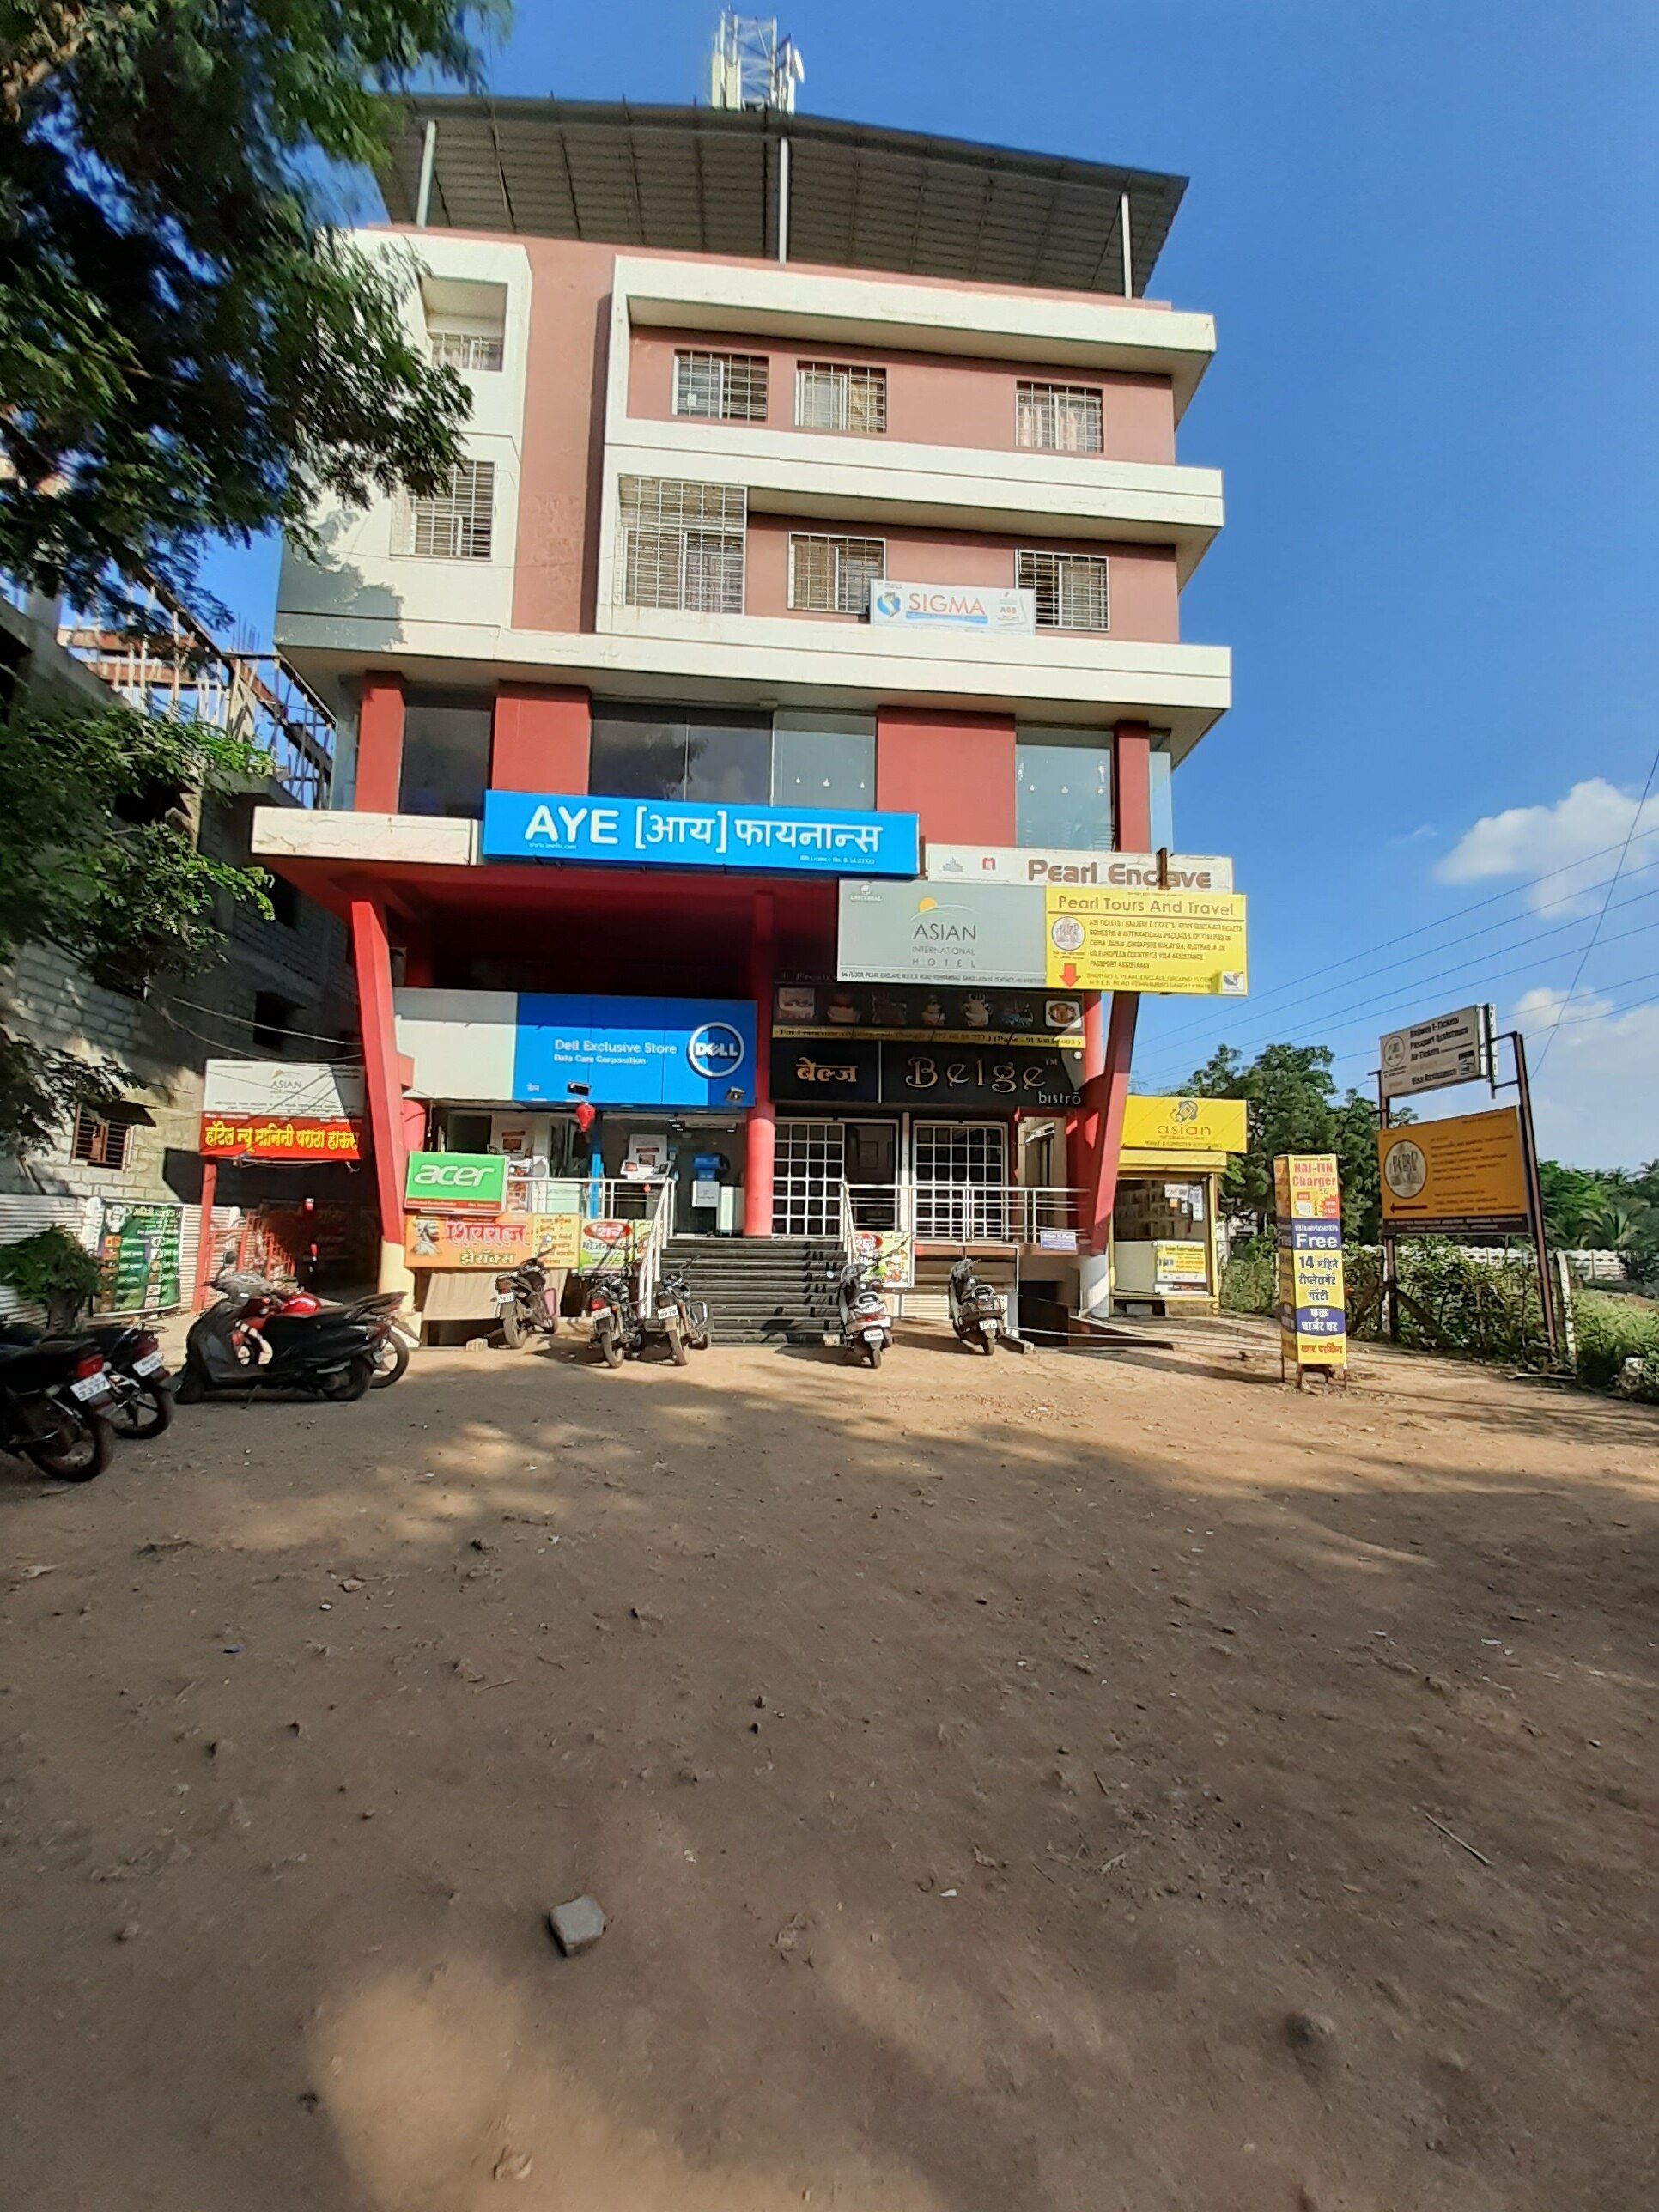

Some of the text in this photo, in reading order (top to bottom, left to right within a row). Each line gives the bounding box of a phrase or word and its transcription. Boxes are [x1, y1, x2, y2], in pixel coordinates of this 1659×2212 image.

[908, 592, 986, 615] SIGMA
[524, 805, 619, 844] AYE
[735, 818, 884, 853] फायनान्स
[1029, 859, 1212, 890] Pearl Encave
[1058, 896, 1235, 916] Pearl Tours And Travel
[913, 923, 977, 941] ASIAN
[912, 945, 975, 956] INTERNATIONAL
[912, 958, 975, 968] HOTEL
[554, 1039, 678, 1054] Dell Exclusive Store
[695, 1042, 738, 1057] DELL
[554, 1054, 574, 1062] Data
[596, 1054, 647, 1065] Corporation
[905, 1056, 1046, 1093] Belge
[1157, 1123, 1211, 1135] asian
[414, 1164, 495, 1187] acer
[1292, 1176, 1336, 1187] Charger
[1295, 1224, 1339, 1232] Bluetooth
[1296, 1233, 1338, 1248] Free
[1299, 1256, 1315, 1268] 14
